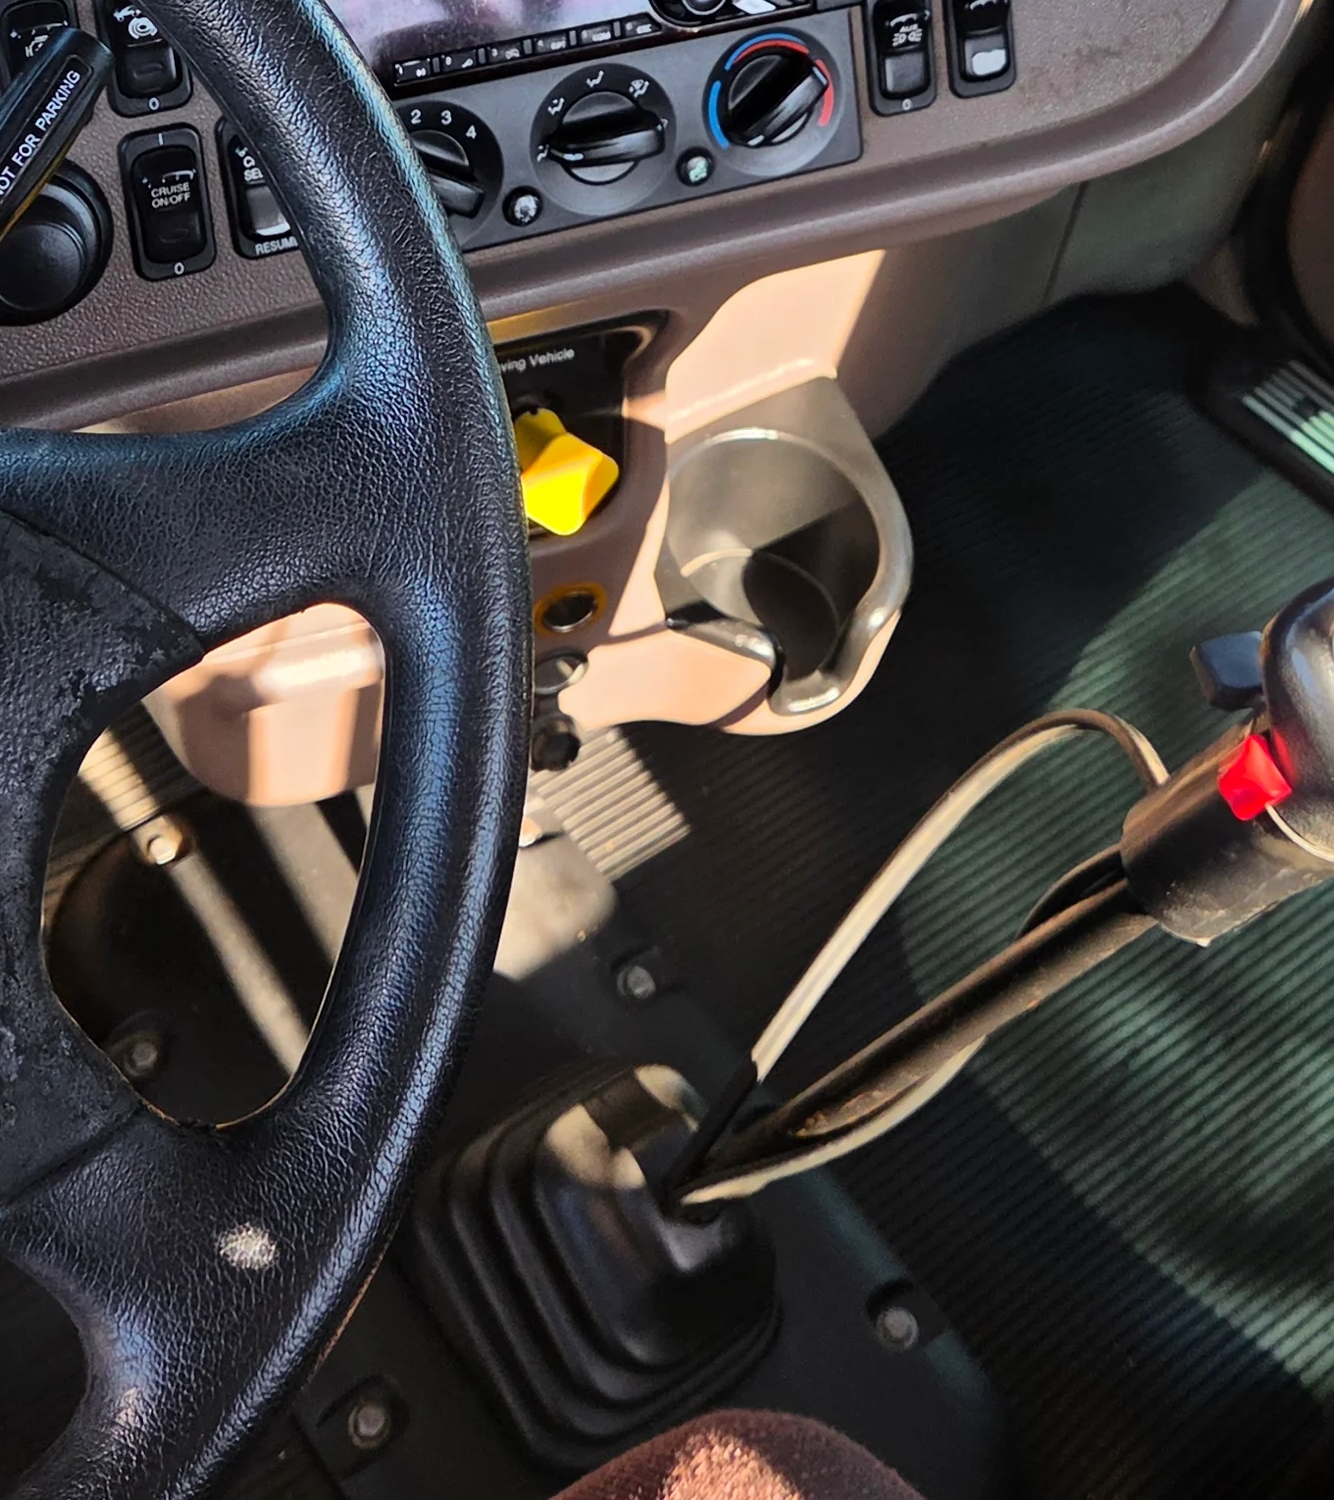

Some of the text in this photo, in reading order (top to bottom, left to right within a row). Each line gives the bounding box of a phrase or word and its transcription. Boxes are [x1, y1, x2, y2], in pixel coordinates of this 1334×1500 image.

[12, 134, 40, 166] FOR
[35, 70, 80, 131] PARKING
[411, 109, 421, 124] 2
[441, 110, 452, 125] 3
[465, 125, 477, 139] 4
[151, 182, 190, 198] CRUISE
[152, 193, 191, 208] ON/OFF
[501, 348, 575, 373] ving Vehicle
